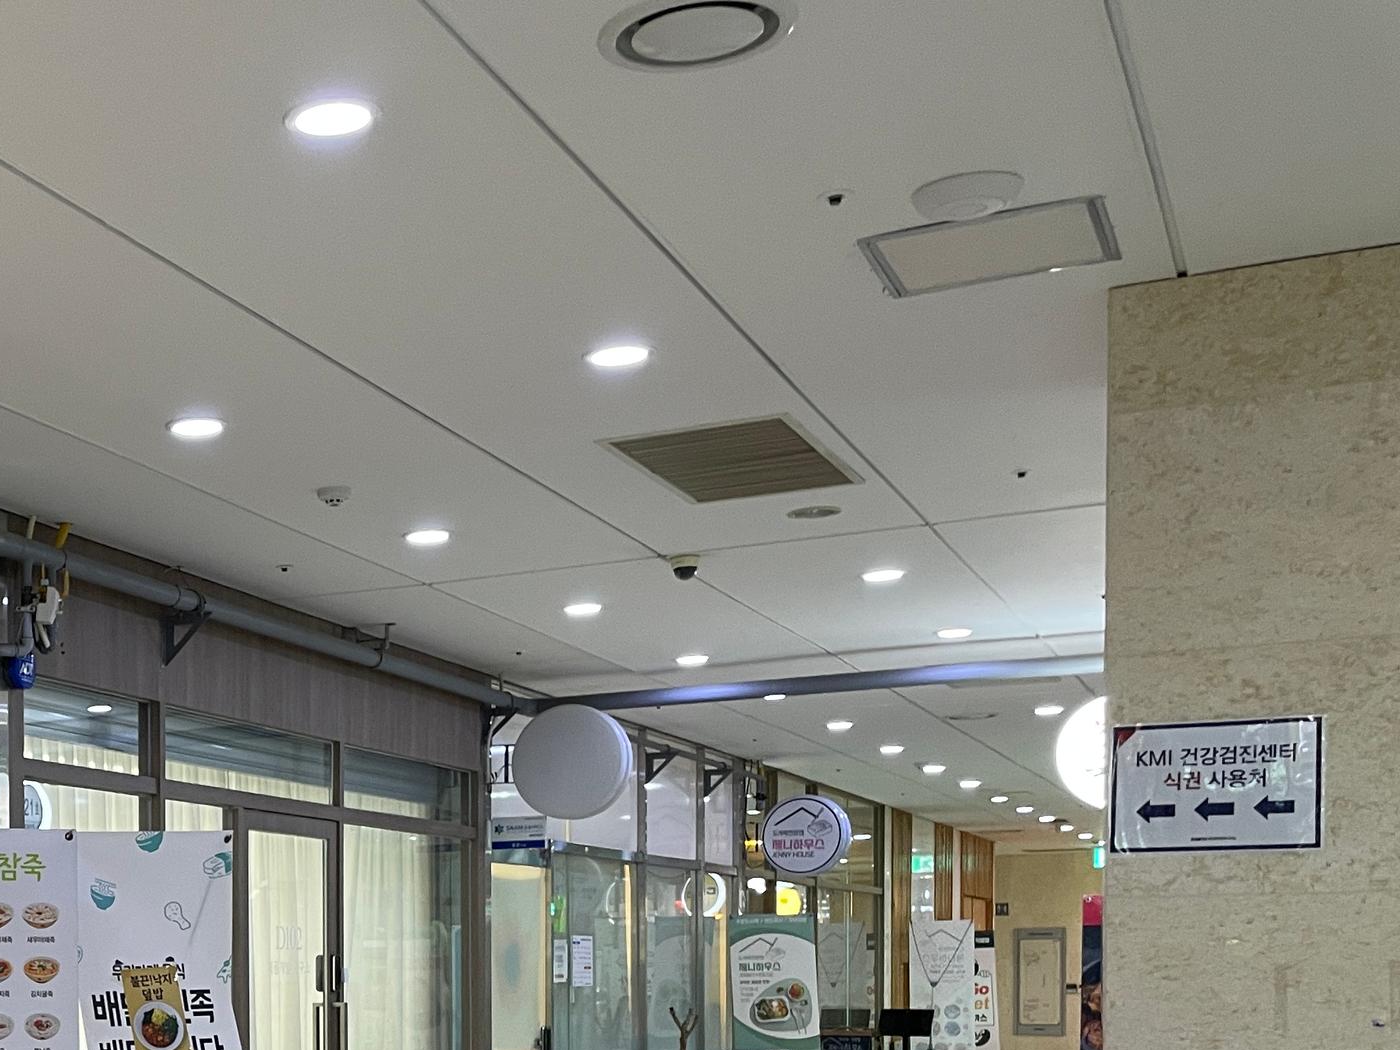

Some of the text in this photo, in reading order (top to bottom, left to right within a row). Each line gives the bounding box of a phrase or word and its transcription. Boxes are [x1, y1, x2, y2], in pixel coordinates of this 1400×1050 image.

[1135, 743, 1297, 768] KMI 건강검진센터
[1163, 767, 1267, 791] 식권 사용처
[141, 987, 164, 1001] 덮밥
